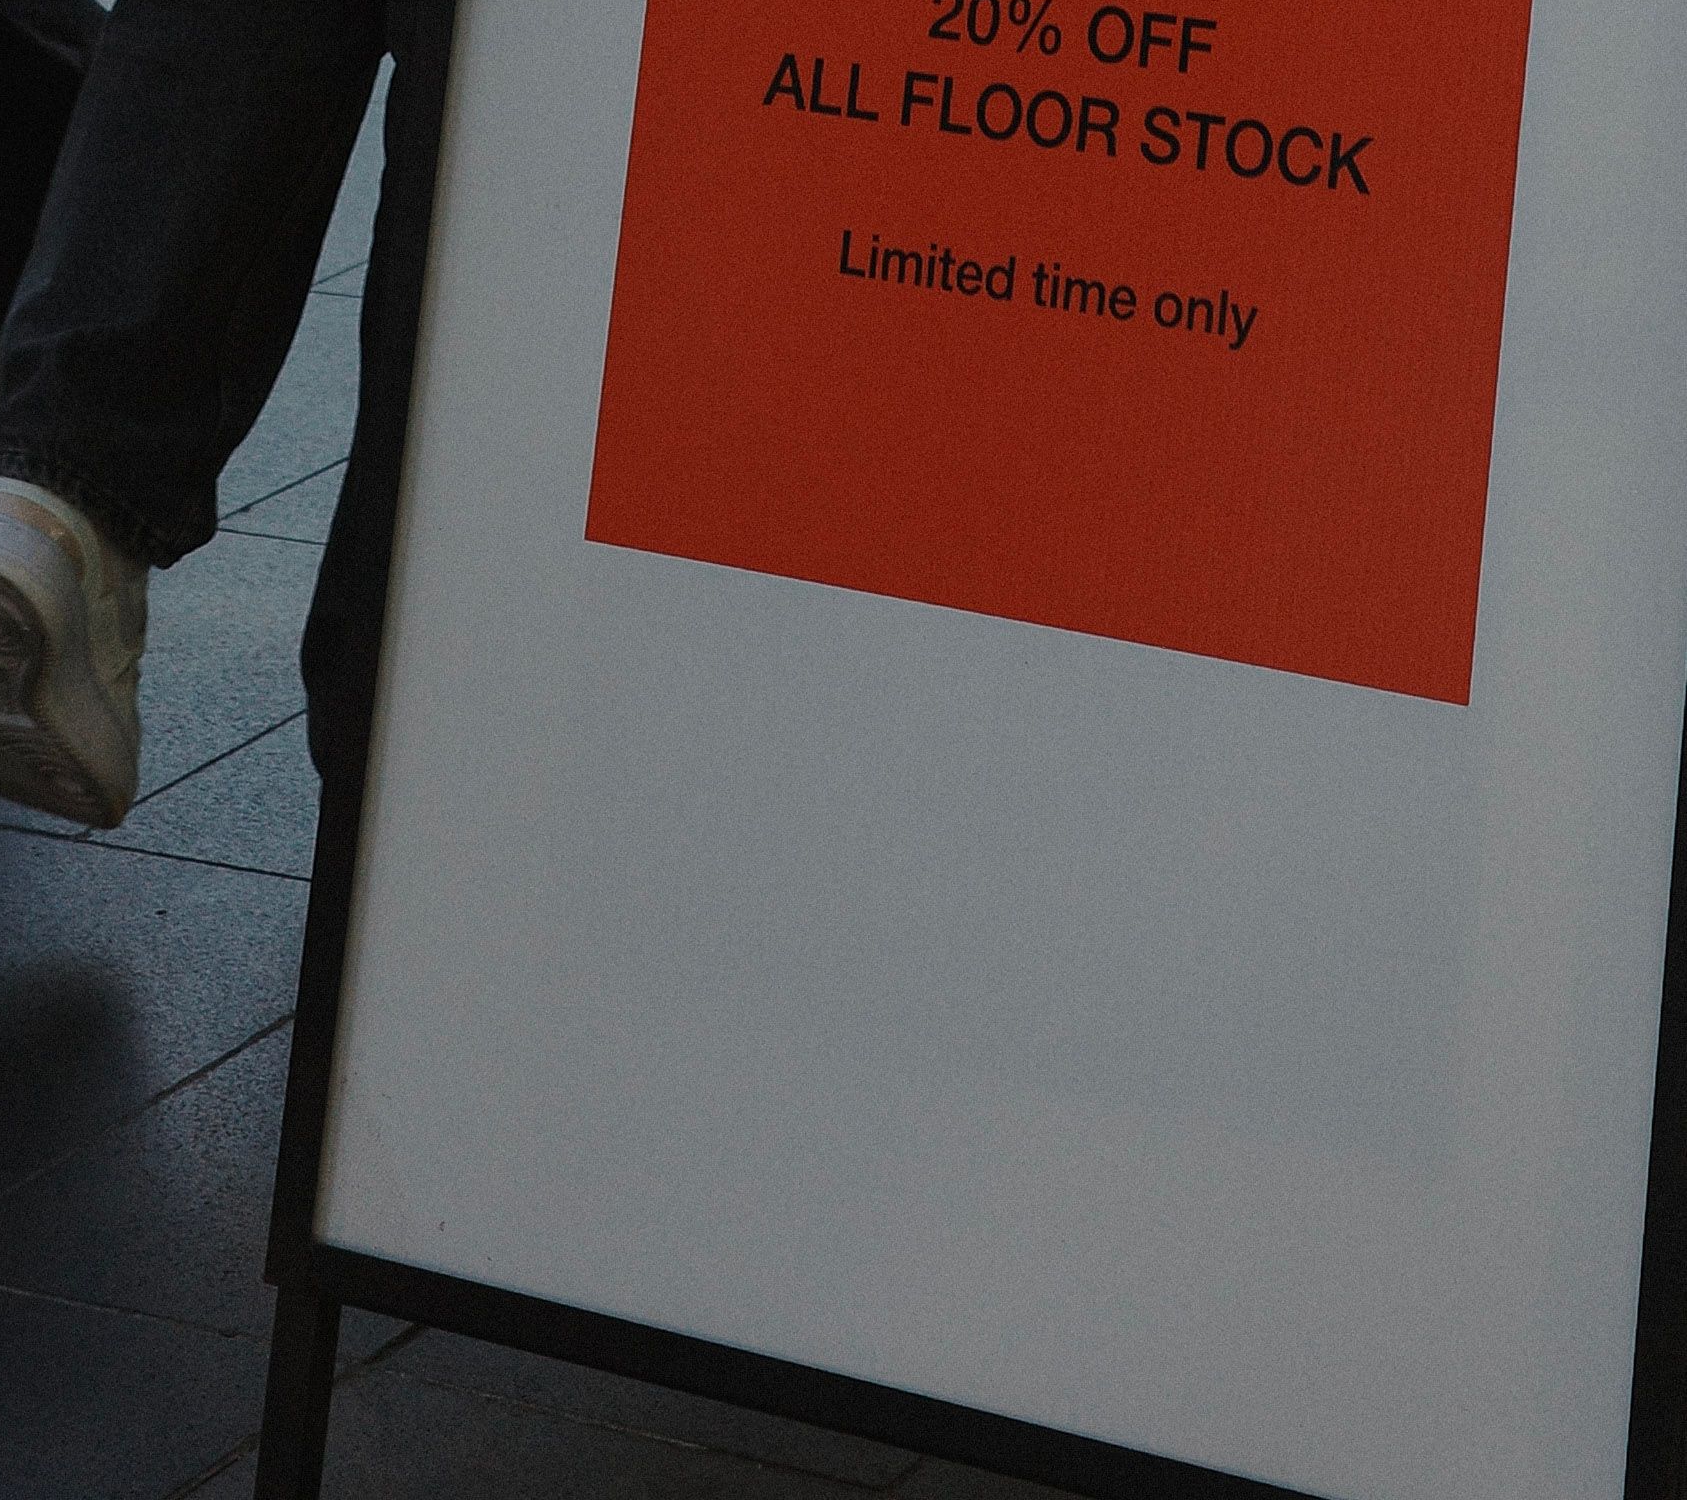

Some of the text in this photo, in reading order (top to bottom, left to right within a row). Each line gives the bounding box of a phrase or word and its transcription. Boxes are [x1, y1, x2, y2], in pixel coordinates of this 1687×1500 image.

[1086, 4, 1218, 74] OFF
[762, 52, 1373, 196] ALL FLOOR STOCK
[838, 229, 1259, 351] Limited time only
